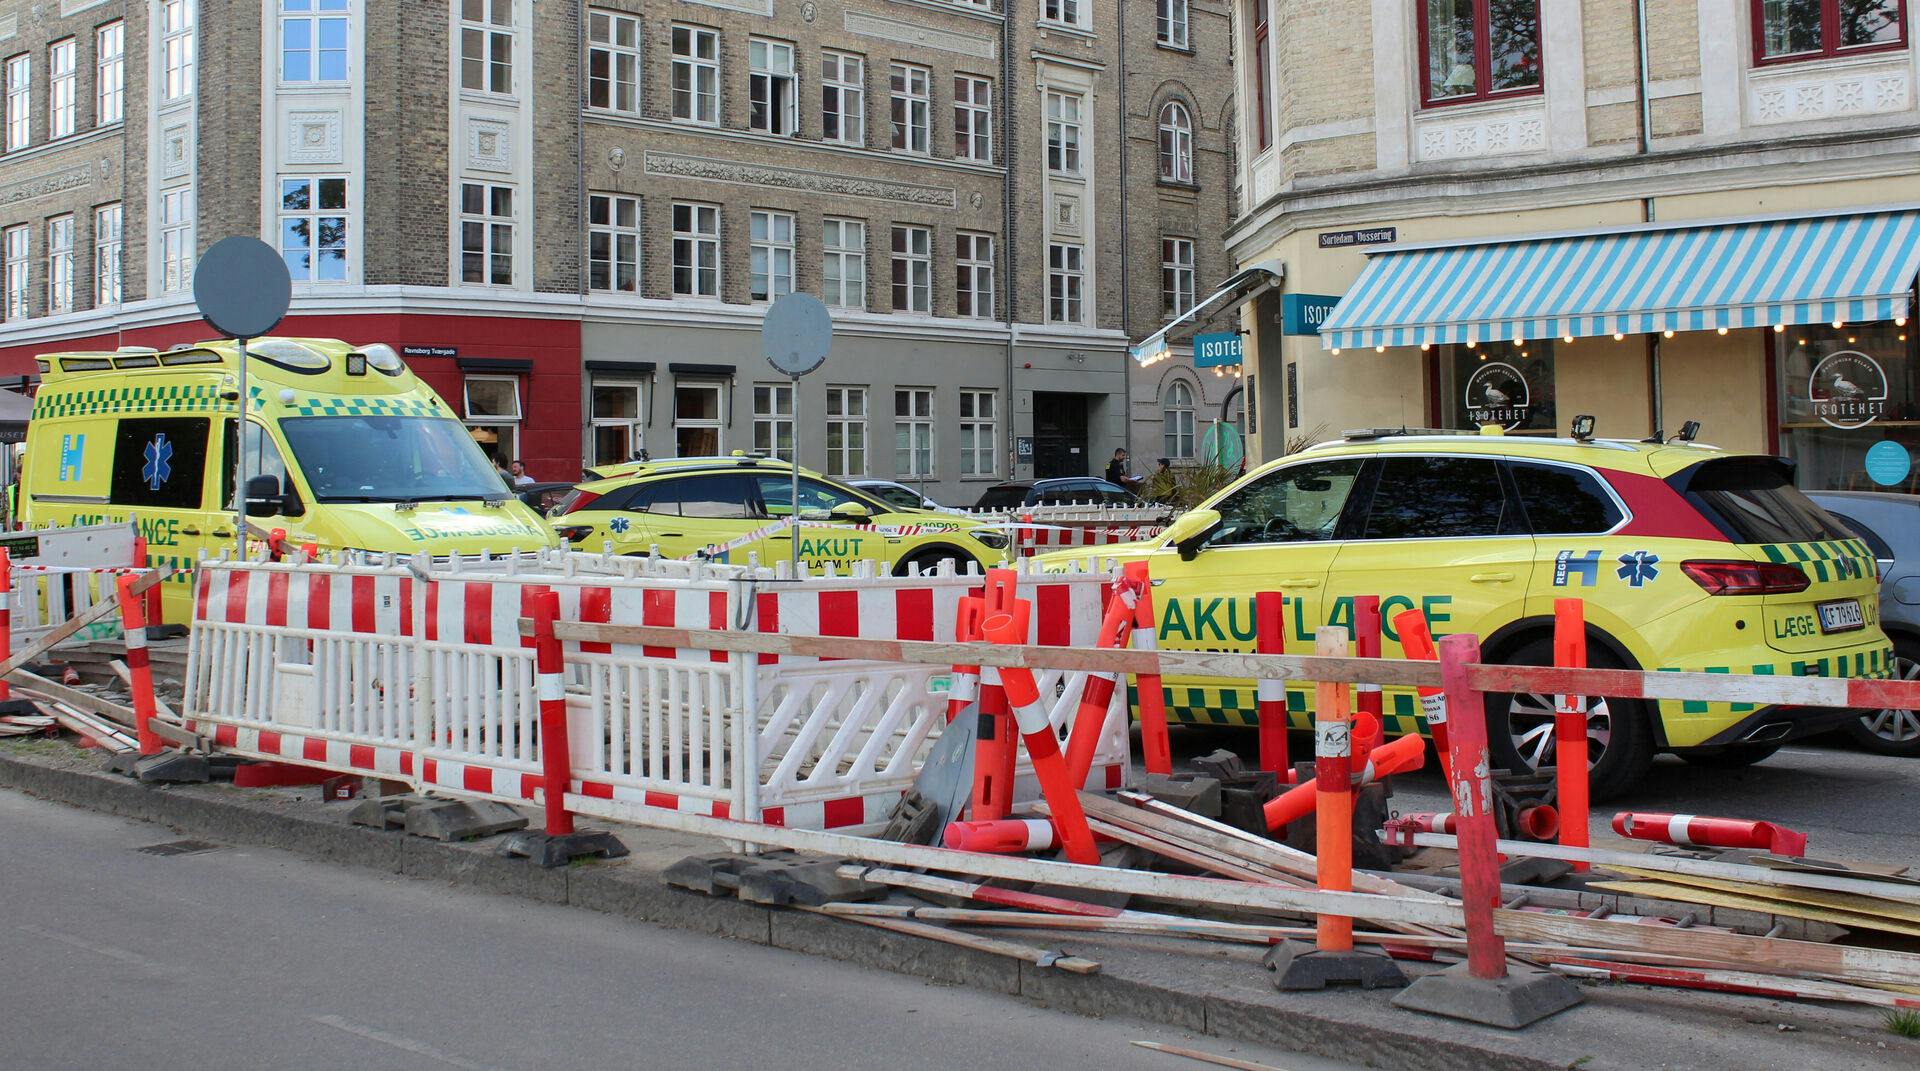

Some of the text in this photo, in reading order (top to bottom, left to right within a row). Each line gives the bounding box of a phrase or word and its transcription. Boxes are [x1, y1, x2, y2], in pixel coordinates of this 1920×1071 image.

[1322, 234, 1354, 245] Sortedam
[800, 538, 863, 557] AKUT
[1556, 551, 1570, 584] REGION
[1774, 615, 1815, 638] LÆGE
